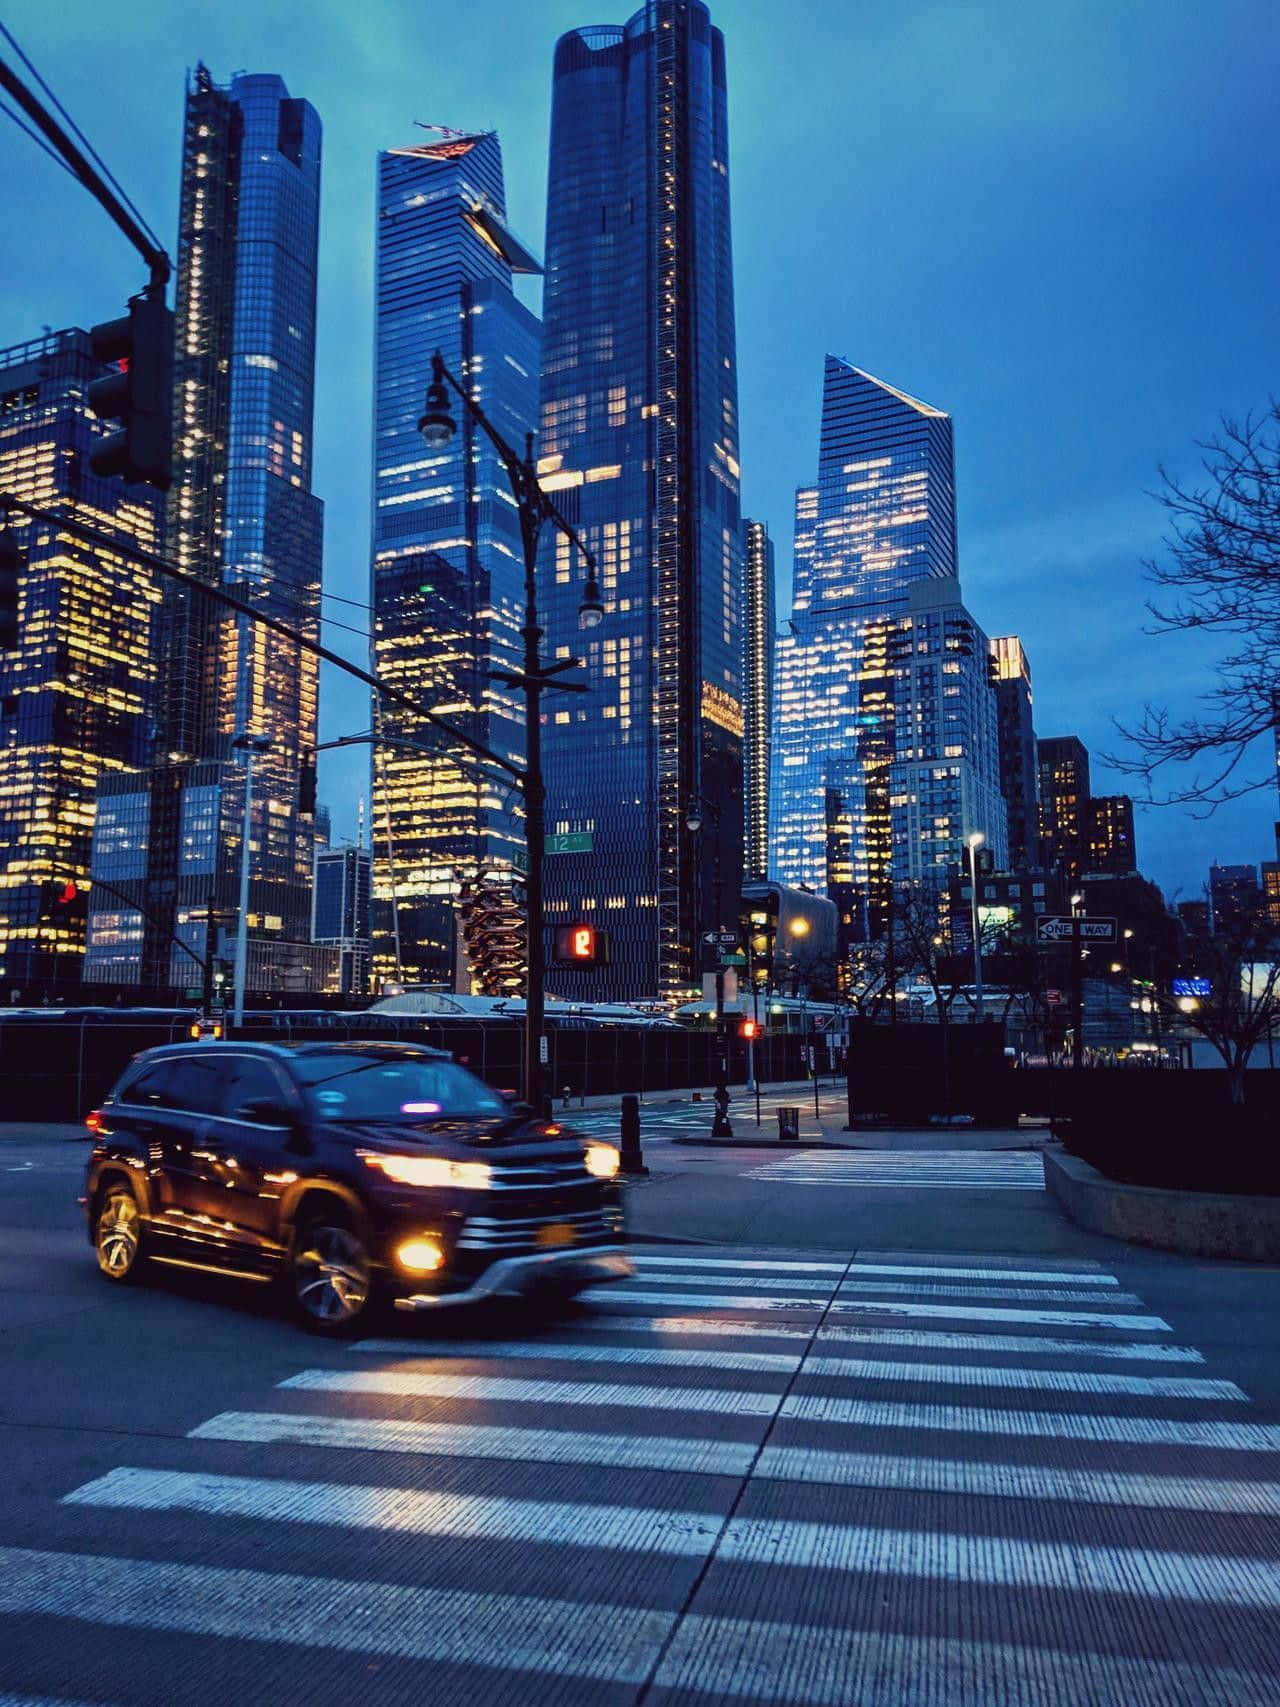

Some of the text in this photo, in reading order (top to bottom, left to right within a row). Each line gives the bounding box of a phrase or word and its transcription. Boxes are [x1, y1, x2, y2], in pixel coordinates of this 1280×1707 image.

[553, 837, 569, 851] 12
[1046, 924, 1109, 935] ONE WAY
